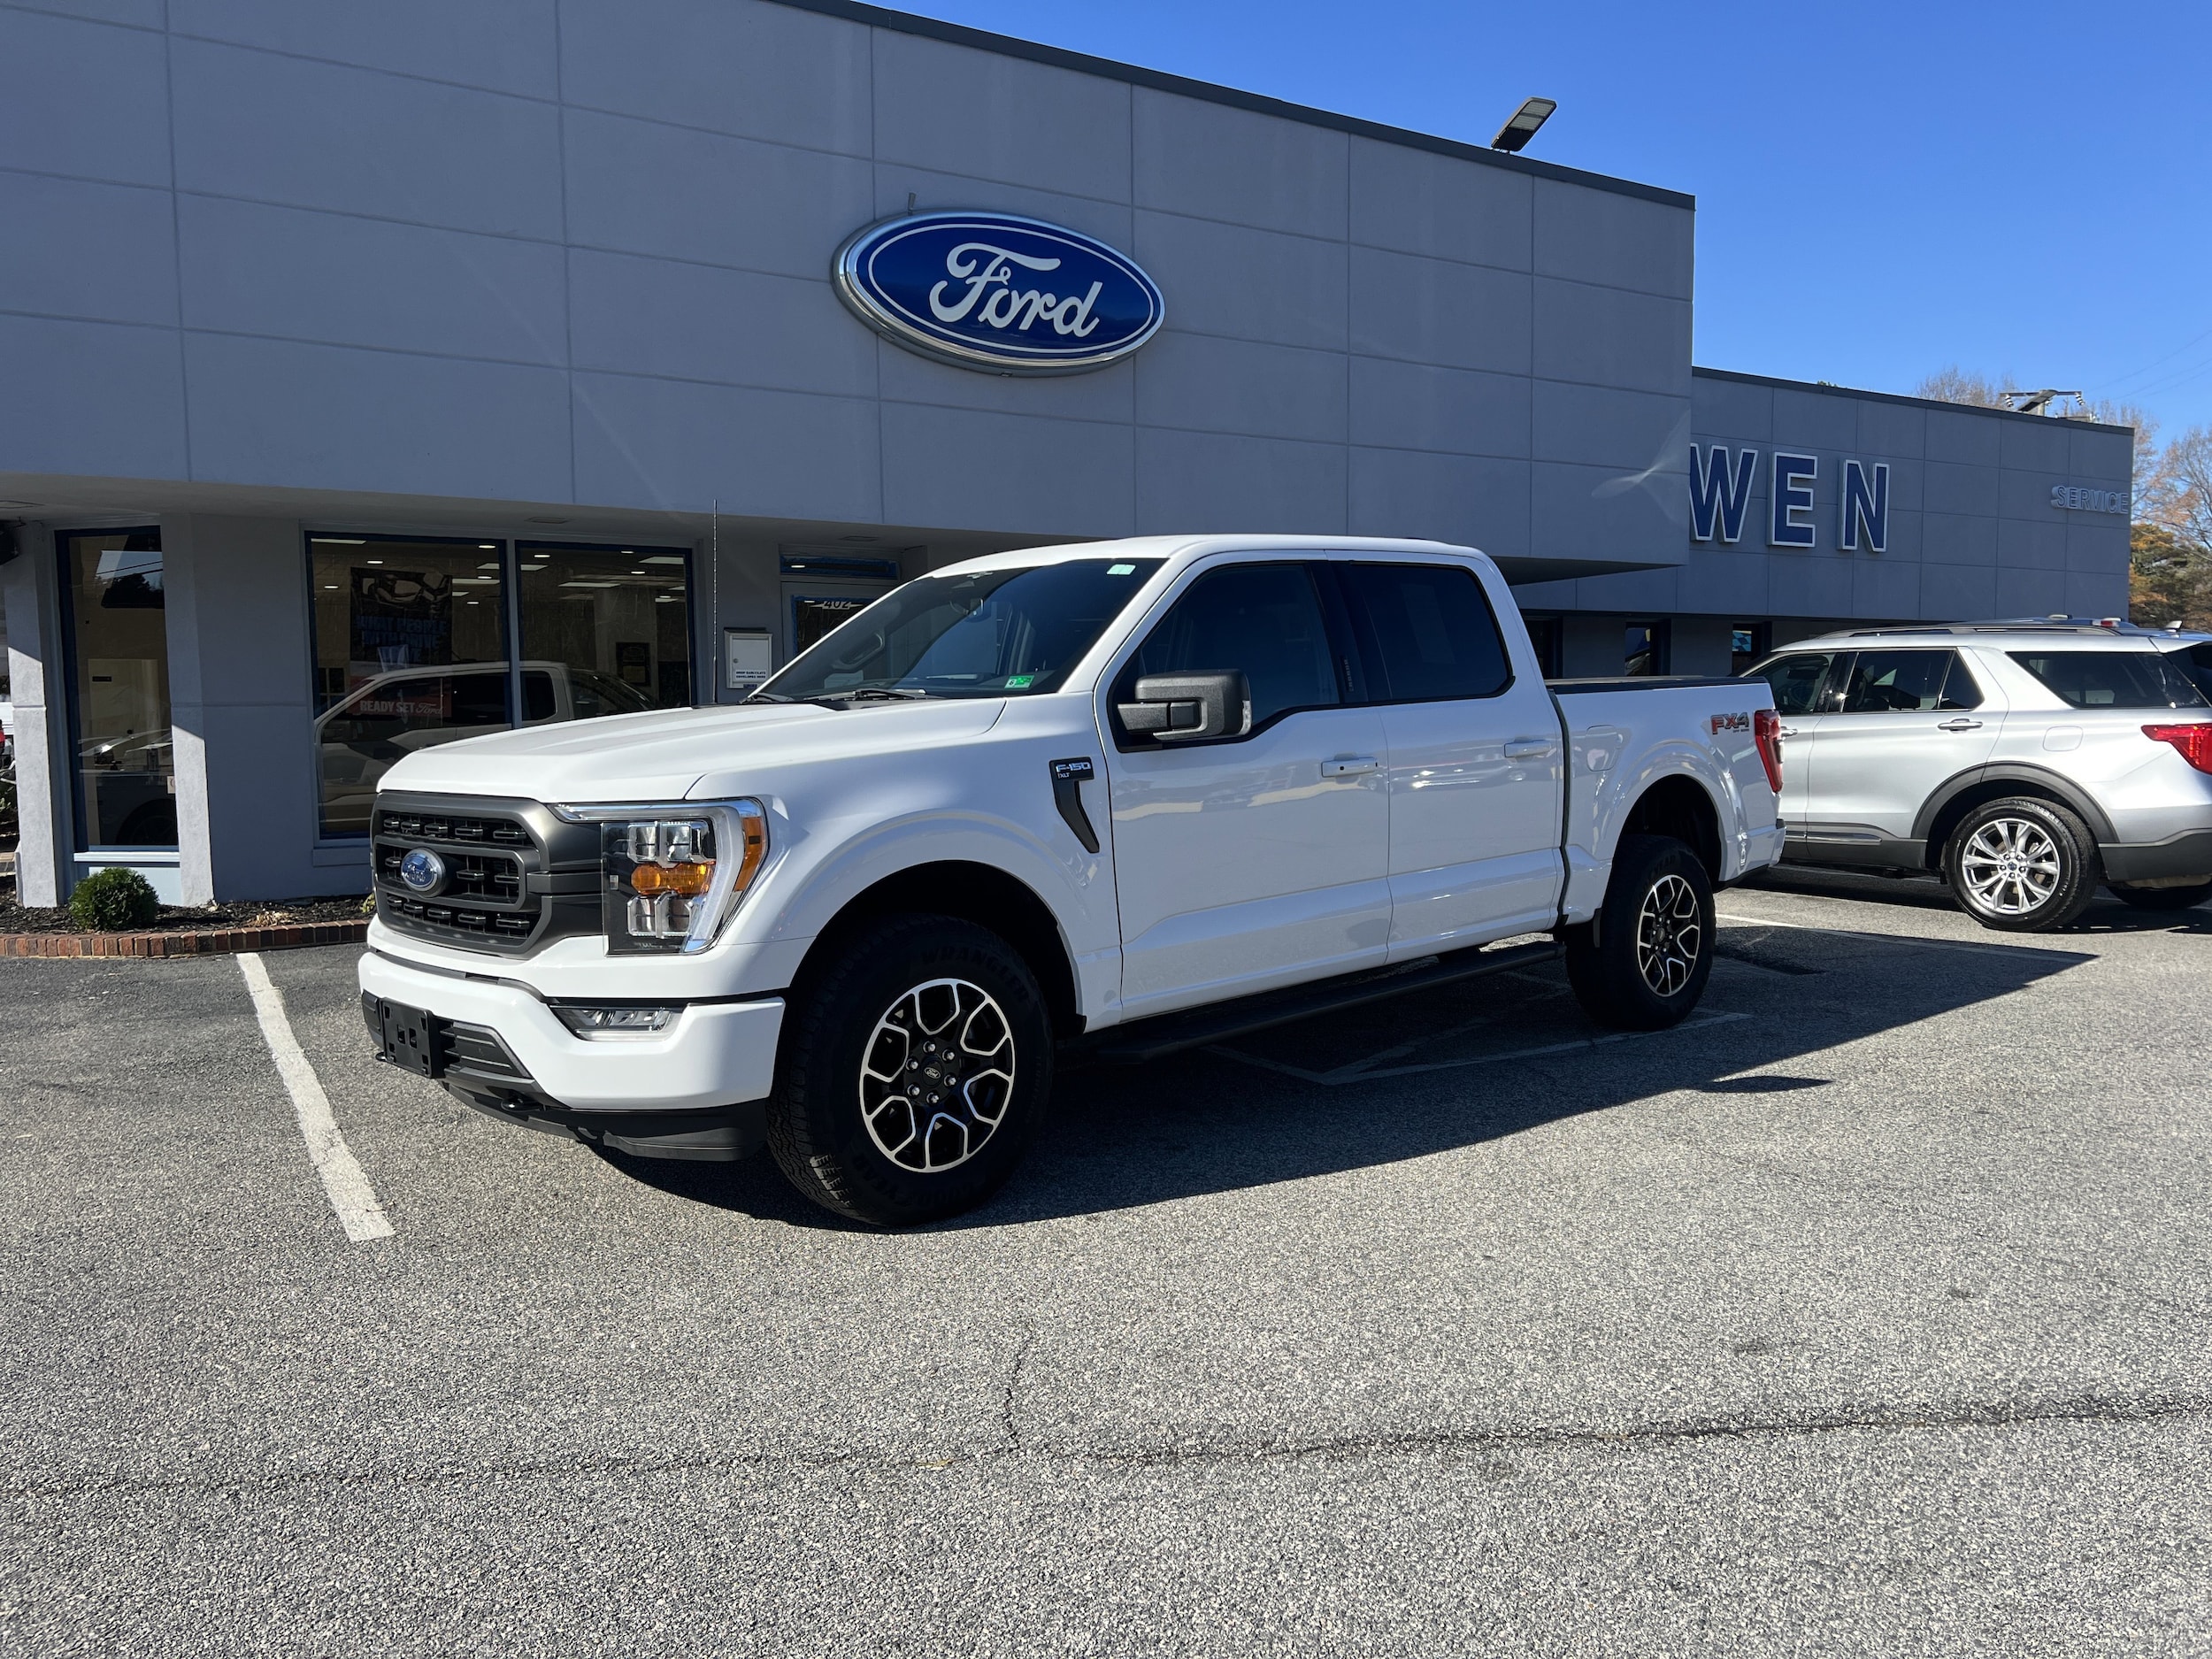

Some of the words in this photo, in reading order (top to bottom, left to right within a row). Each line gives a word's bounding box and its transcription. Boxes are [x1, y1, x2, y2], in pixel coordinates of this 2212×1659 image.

[929, 242, 1102, 337] Ford
[1690, 443, 1890, 552] WEN
[2052, 486, 2129, 514] SERVICE
[360, 700, 396, 711] READY
[396, 703, 415, 713] SET
[417, 703, 443, 714] Ford
[1710, 711, 1749, 734] FX4
[1056, 762, 1092, 772] F-150
